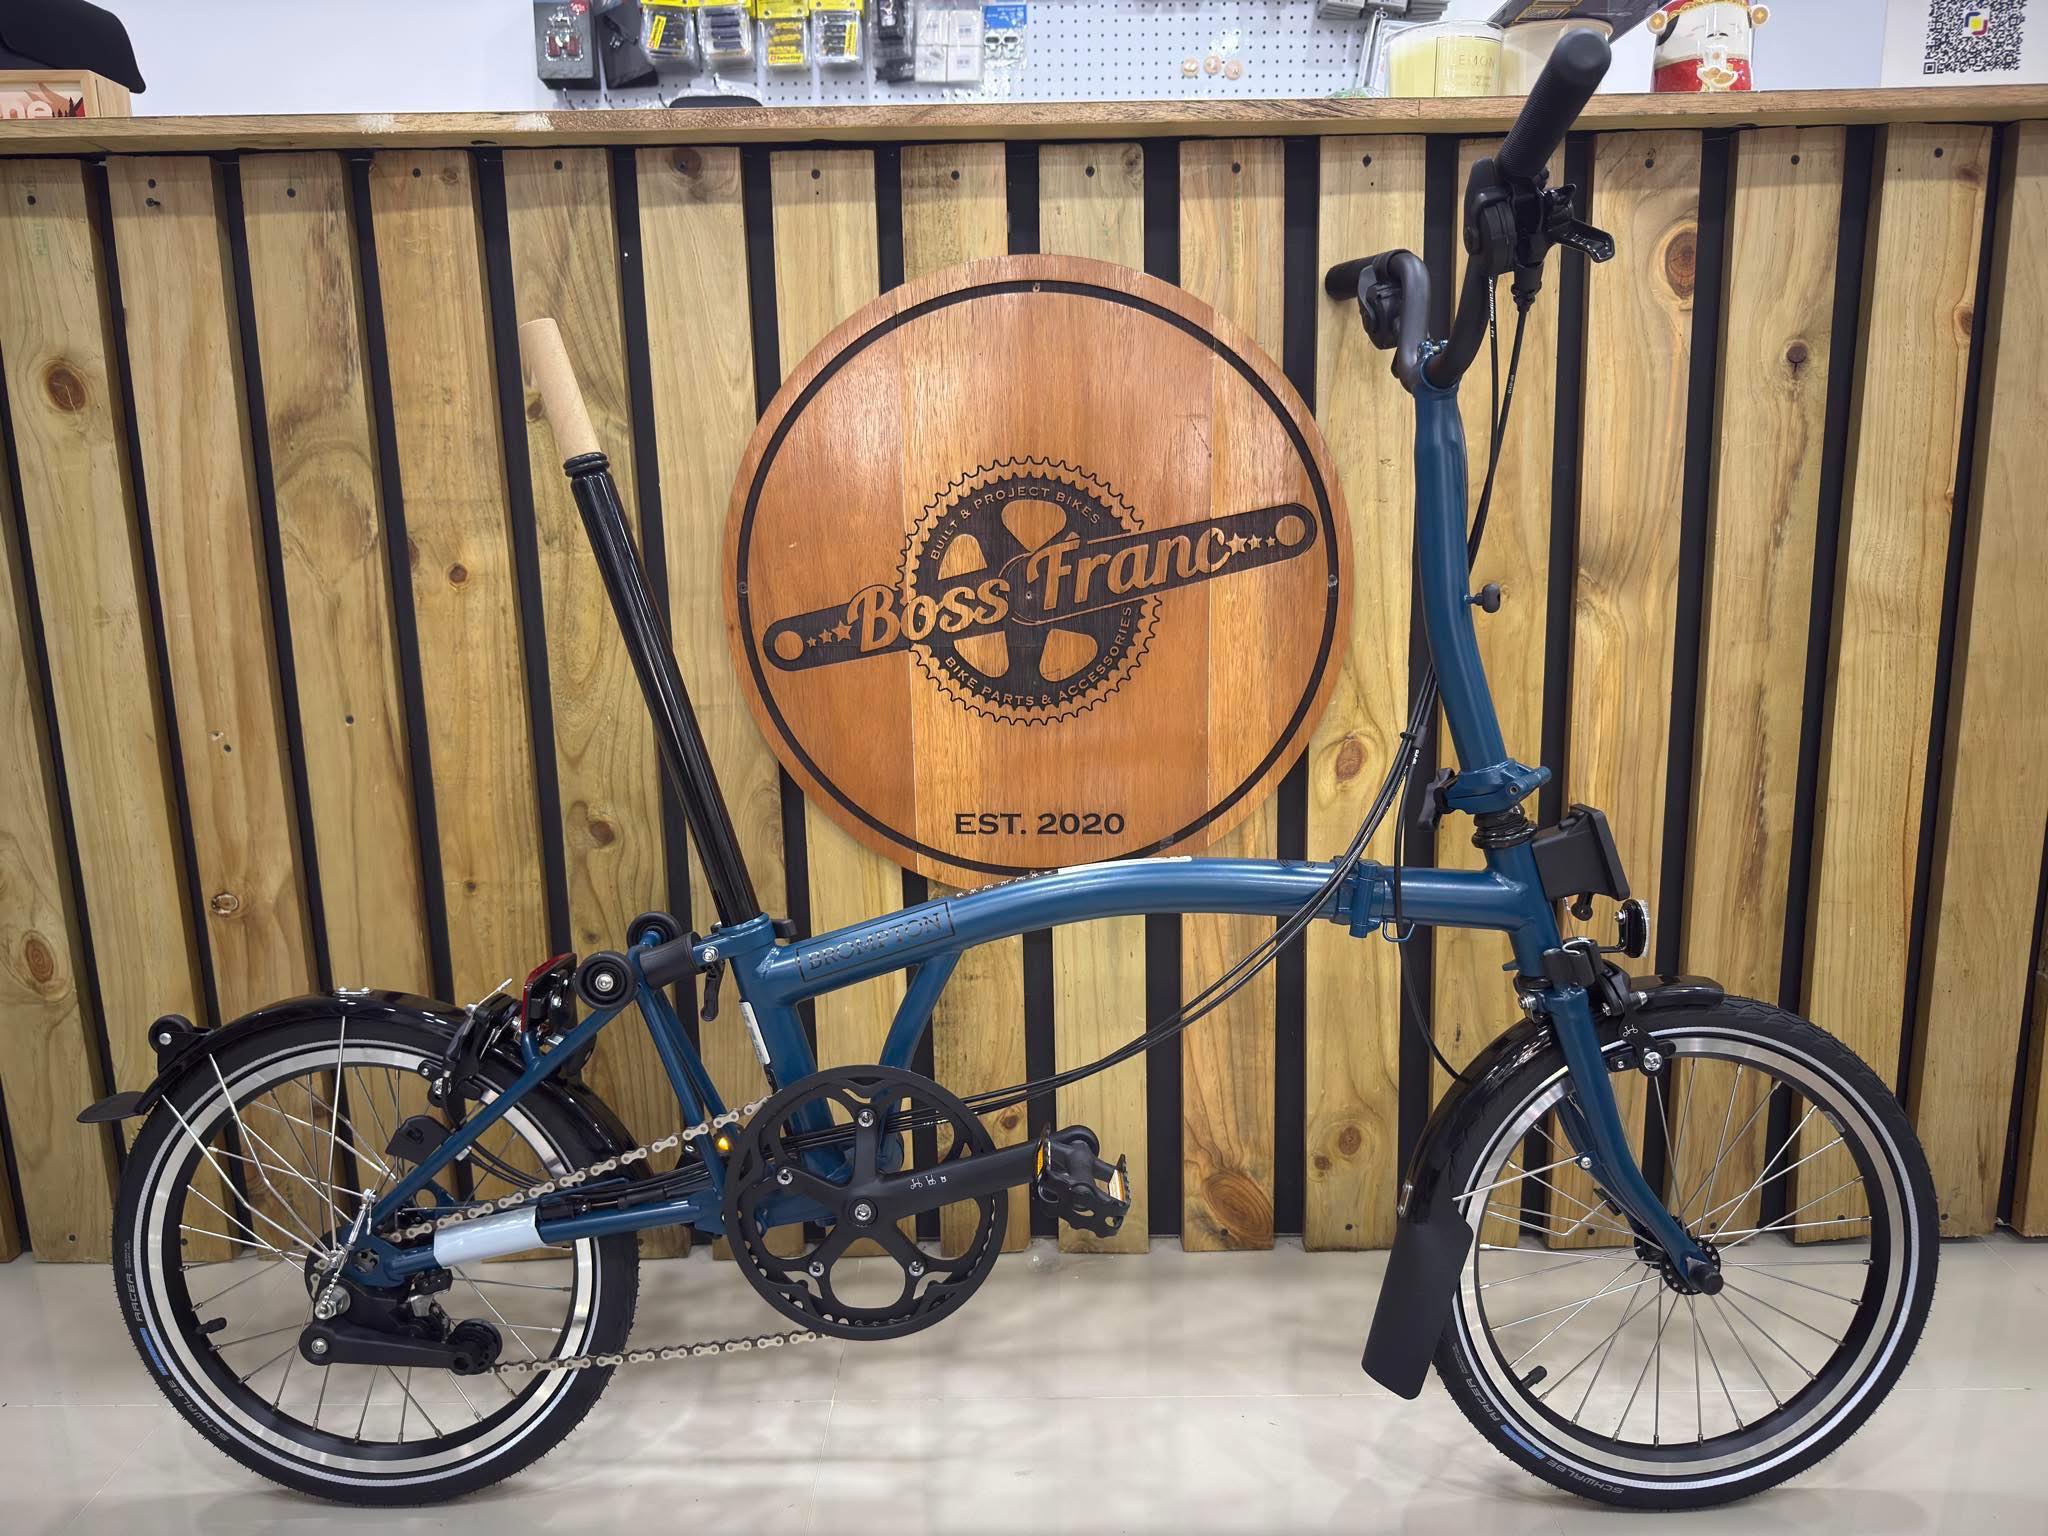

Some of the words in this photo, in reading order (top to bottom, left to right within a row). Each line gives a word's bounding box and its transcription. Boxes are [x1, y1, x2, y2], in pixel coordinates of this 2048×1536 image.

[930, 519, 958, 561] BUILT
[960, 508, 971, 520] &
[973, 486, 1050, 510] PROJECT
[1055, 491, 1100, 525] BIKES
[847, 578, 1011, 653] Boss
[1026, 527, 1232, 611] Franc
[944, 656, 978, 689] BIKE
[981, 686, 1035, 706] PARTS
[1041, 694, 1052, 705] &
[1058, 606, 1132, 701] ACCESSORIES
[955, 813, 1027, 835] EST.
[1037, 813, 1125, 835] 2020
[808, 911, 943, 970] BROMPTON
[127, 1272, 144, 1323] RACER
[167, 1379, 230, 1442] SCHWALBE
[1465, 1377, 1500, 1423] RACER
[1546, 1459, 1625, 1495] SCHWALBE
